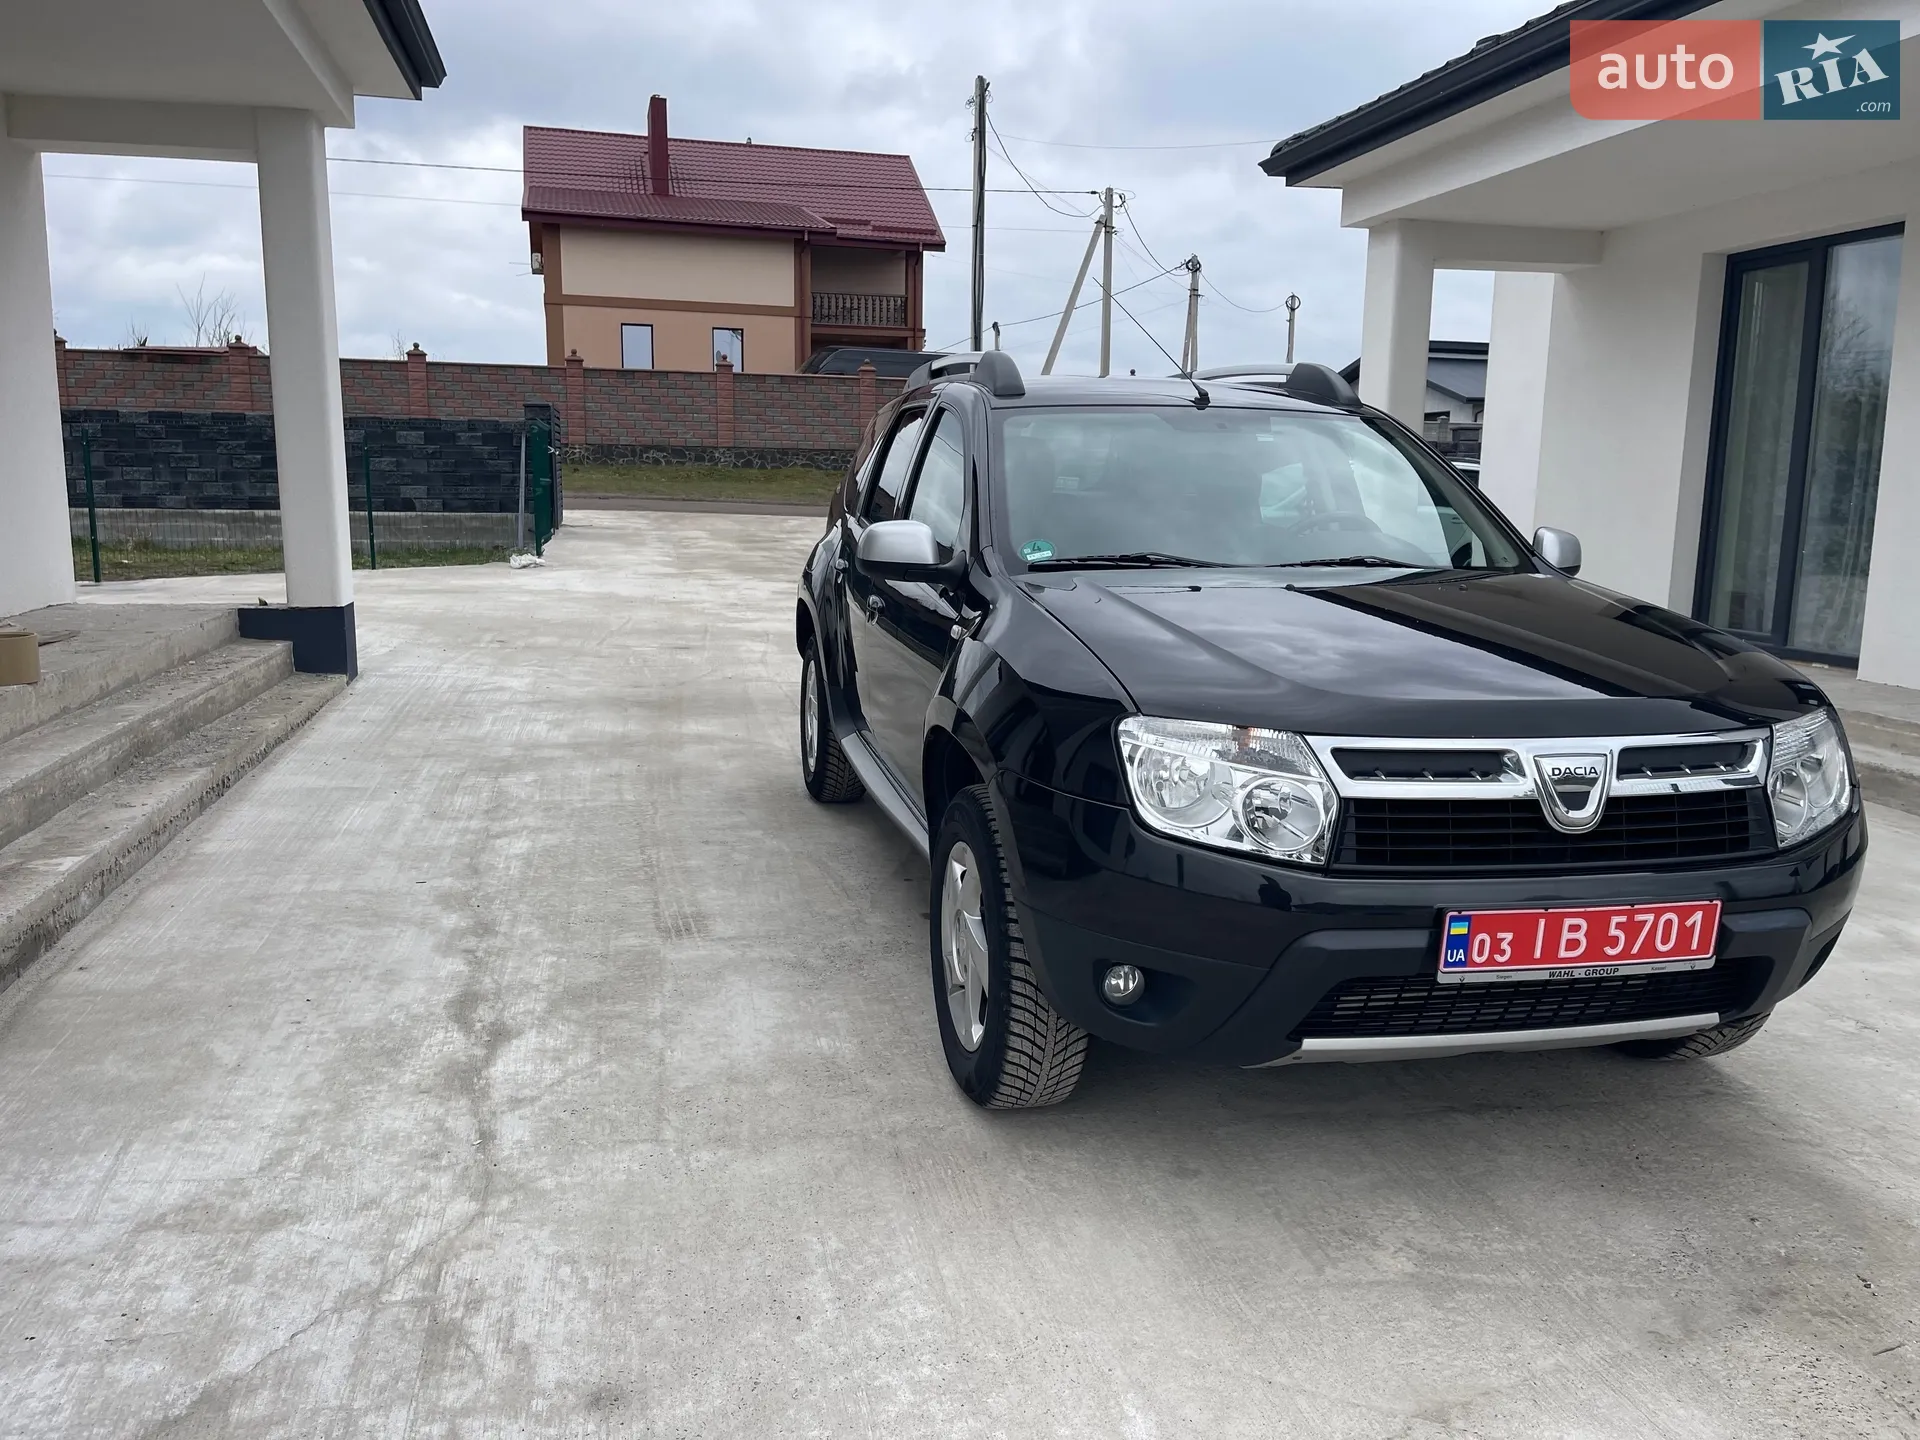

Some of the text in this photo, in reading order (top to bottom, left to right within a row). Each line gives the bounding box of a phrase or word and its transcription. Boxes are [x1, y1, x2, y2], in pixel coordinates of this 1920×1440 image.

[1032, 542, 1041, 552] 4
[1551, 766, 1598, 777] DACIA
[1471, 932, 1514, 964] 03
[1603, 910, 1704, 956] 5701
[1446, 949, 1465, 963] UA
[1548, 970, 1576, 979] WAHL
[1584, 967, 1619, 977] GROUP
